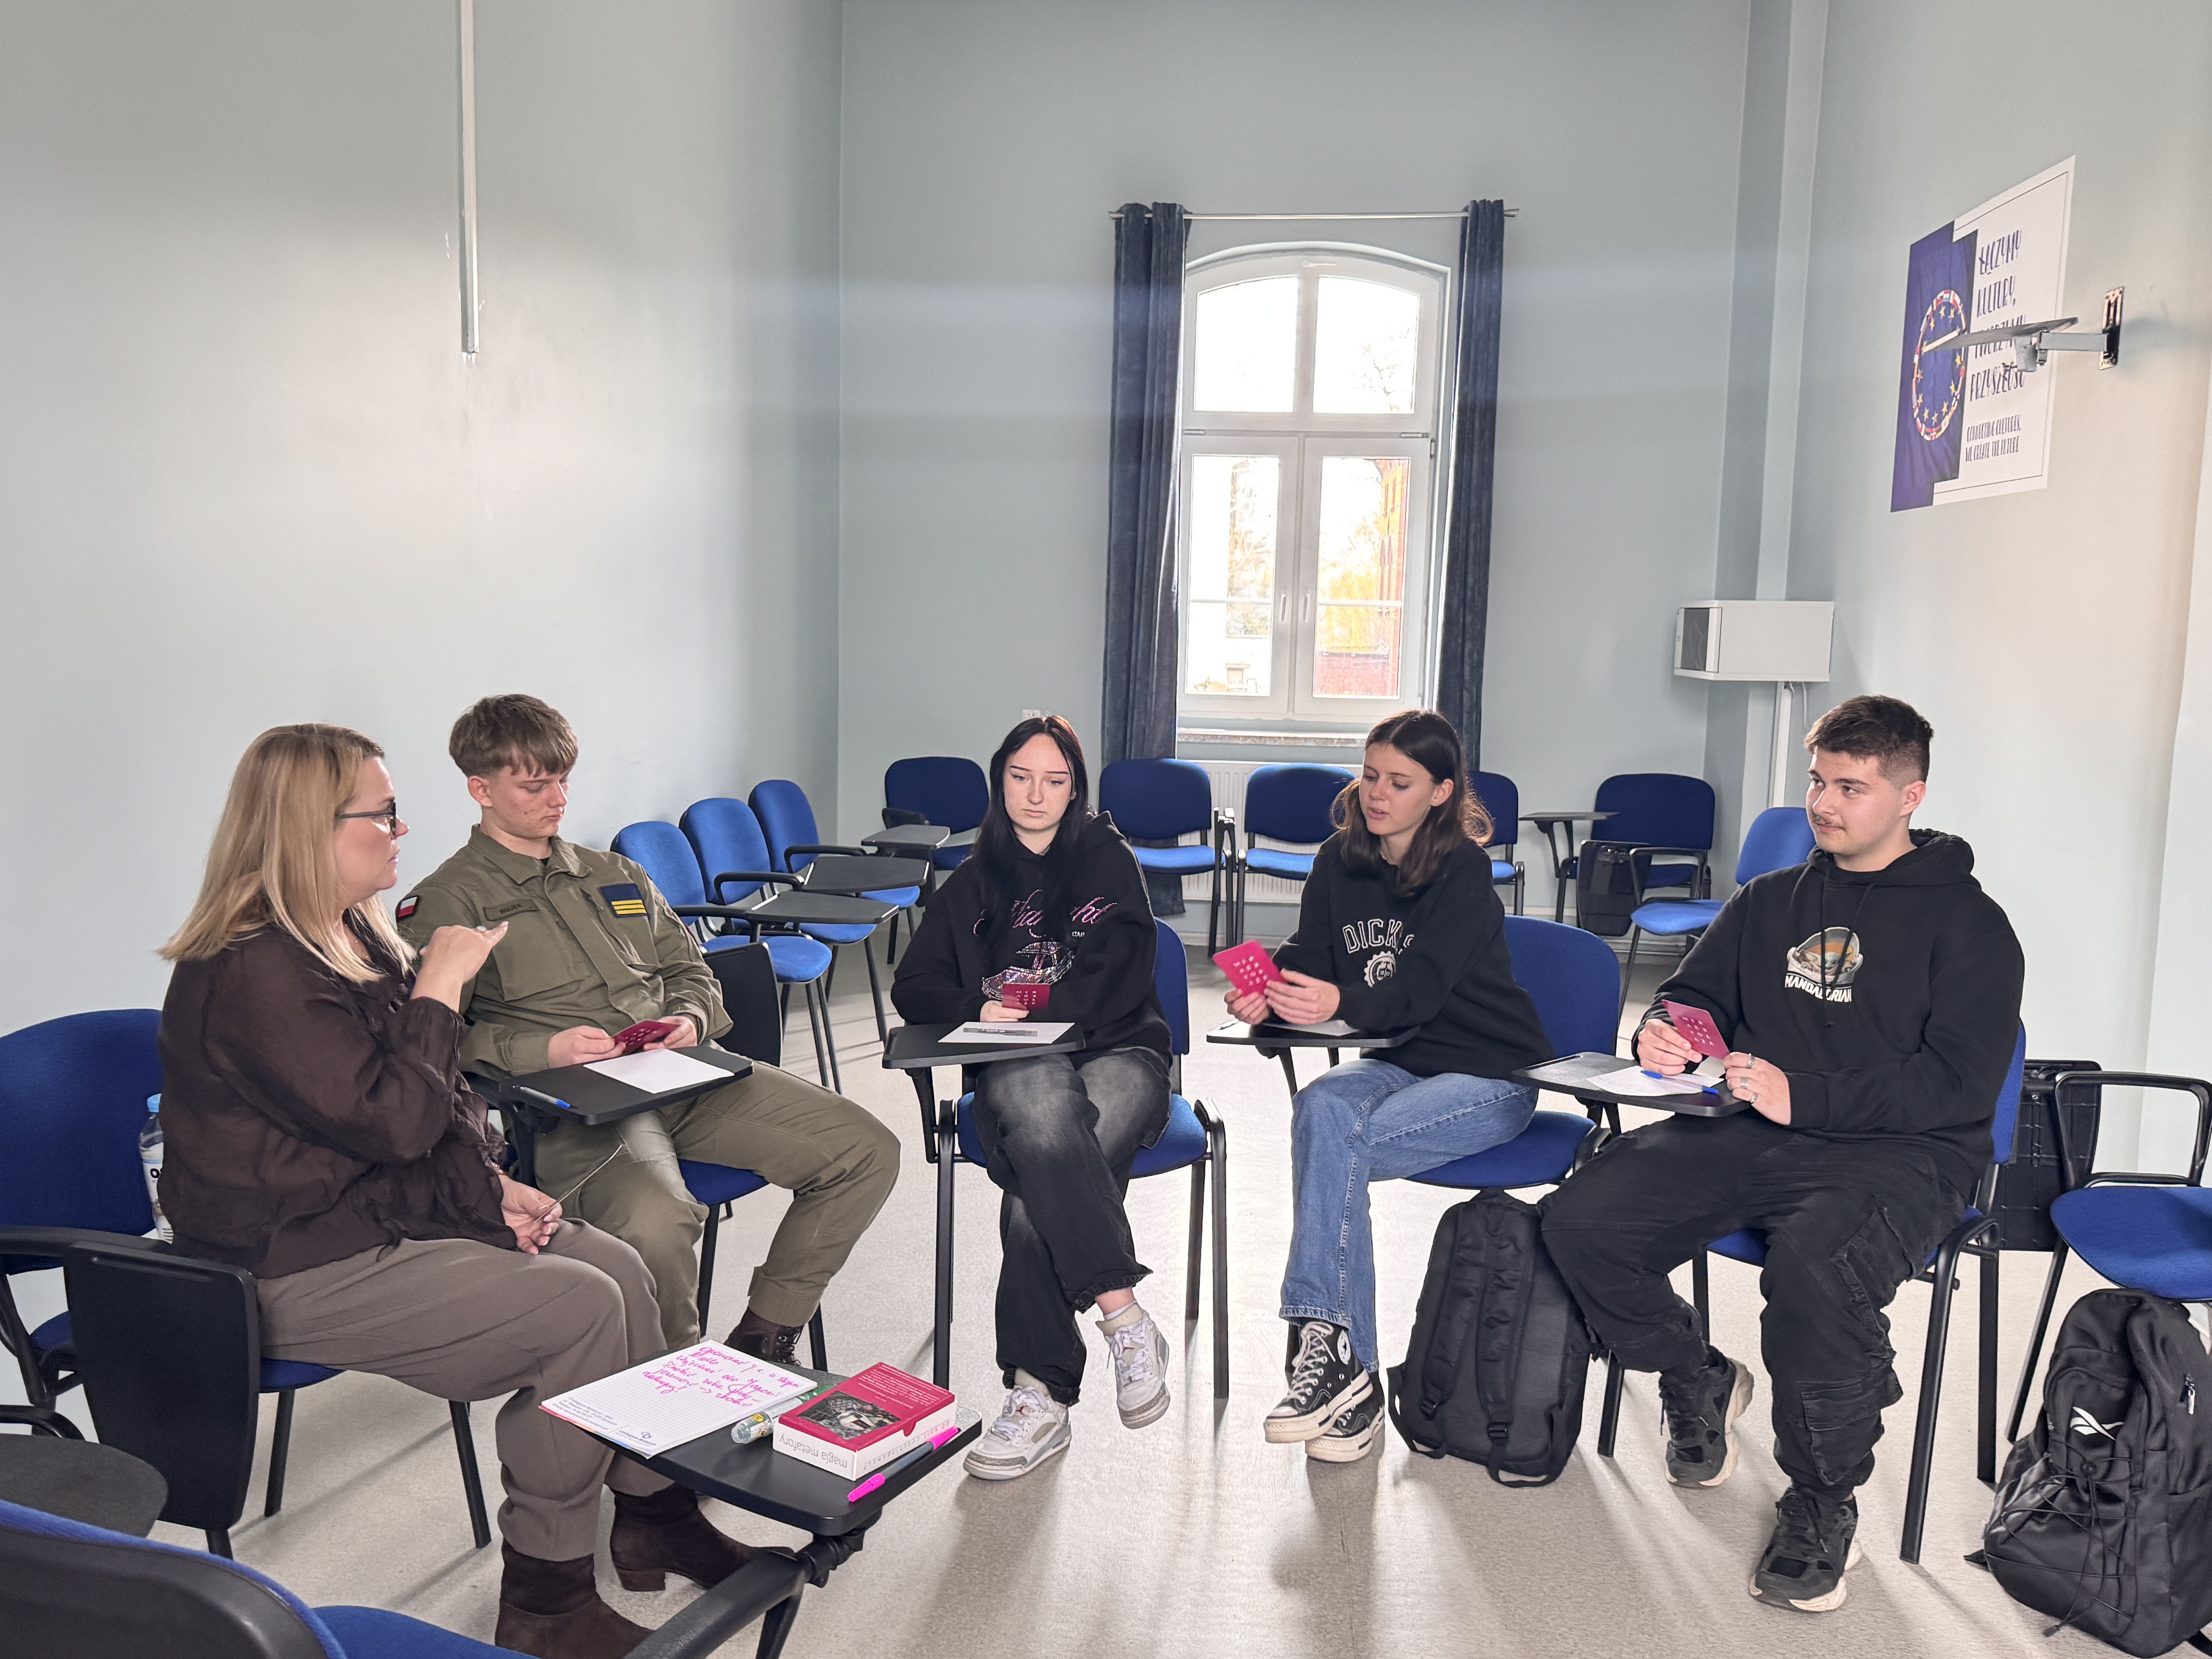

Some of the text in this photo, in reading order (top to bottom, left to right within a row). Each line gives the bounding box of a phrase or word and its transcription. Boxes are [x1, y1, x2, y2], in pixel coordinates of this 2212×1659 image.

[1977, 275, 2016, 318] KULTURY,
[779, 1434, 847, 1468] magia metafory
